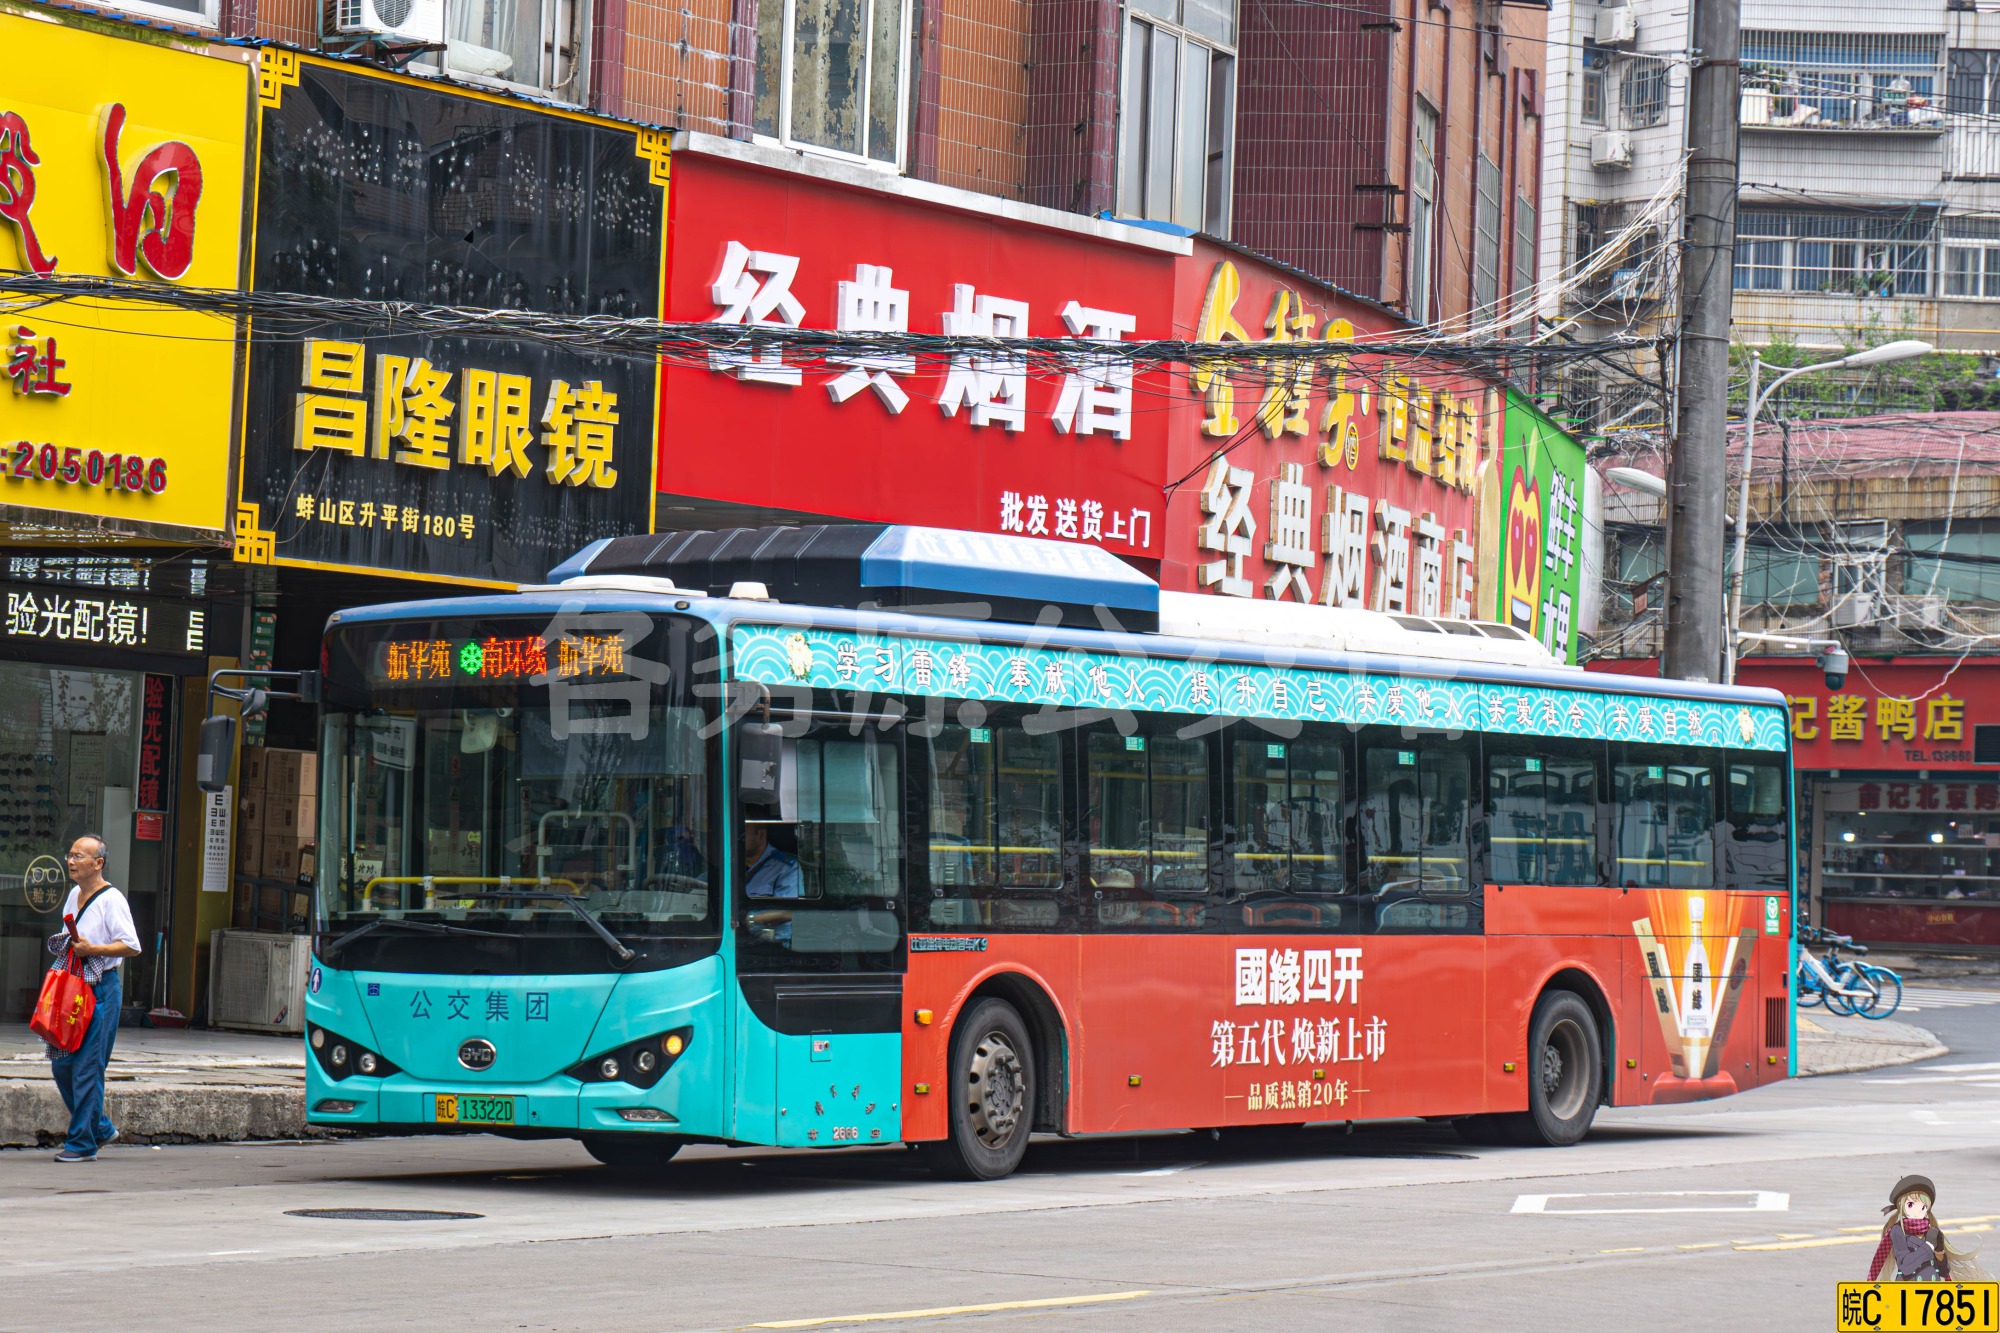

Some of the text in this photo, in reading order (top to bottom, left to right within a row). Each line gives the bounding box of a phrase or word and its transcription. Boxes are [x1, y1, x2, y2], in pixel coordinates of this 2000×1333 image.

[709, 240, 1138, 442] 经典烟酒
[293, 336, 620, 489] 昌隆眼镜
[295, 493, 477, 540] 蚌山区升平街180号
[1199, 450, 1475, 621] 经典烟酒商店
[481, 635, 548, 678] 南环线
[1789, 692, 1966, 742] 记酱鸭店
[140, 676, 165, 809] 验光配镜
[32, 887, 58, 905] 验光
[409, 989, 550, 1022] 公交集团
[460, 1046, 493, 1062] BYD
[1210, 1015, 1388, 1068] 第五代 焕新上市
[1247, 1078, 1350, 1111] 品质热销20年
